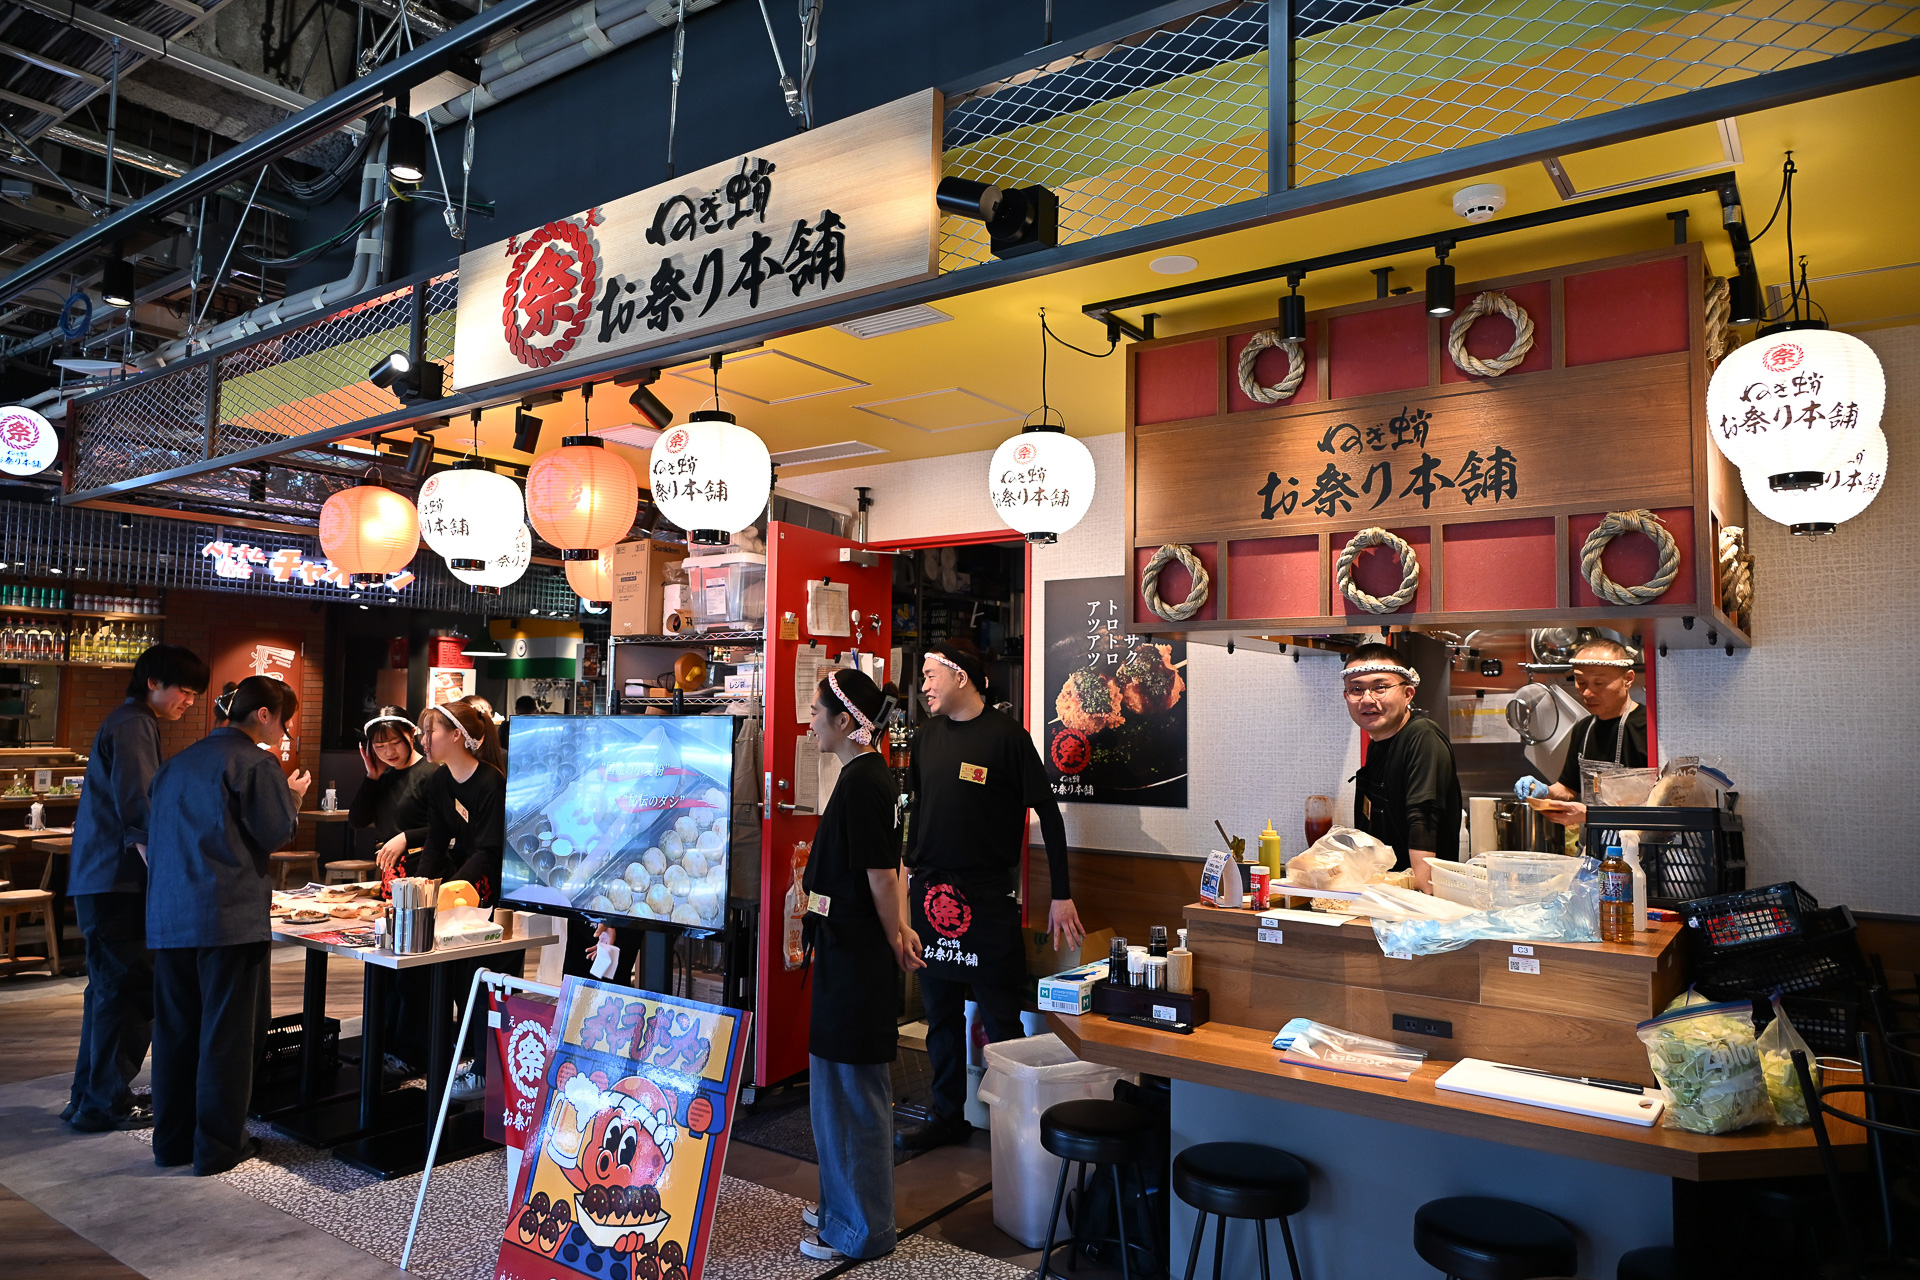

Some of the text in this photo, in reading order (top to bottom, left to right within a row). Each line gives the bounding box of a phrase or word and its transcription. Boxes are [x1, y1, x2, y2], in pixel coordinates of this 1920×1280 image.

[505, 235, 519, 257] 元
[596, 208, 847, 344] お祭り本舗
[517, 245, 579, 340] 祭
[1770, 347, 1797, 367] 祭
[7, 420, 31, 443] 祭
[1719, 400, 1860, 439] お祭り本舗
[1257, 445, 1518, 520] お祭り本舗
[1086, 600, 1101, 667] アツアツ
[1106, 599, 1119, 666] トロトロ
[1058, 735, 1084, 765] 祭
[1050, 782, 1095, 796] お祭り本舗
[1600, 881, 1624, 898] 麦茶
[930, 892, 962, 928] 祭
[924, 944, 979, 968] お祭り本舗
[1517, 946, 1529, 954] C3
[1041, 989, 1049, 997] M
[1083, 998, 1089, 1008] M
[515, 1031, 546, 1083] 祭
